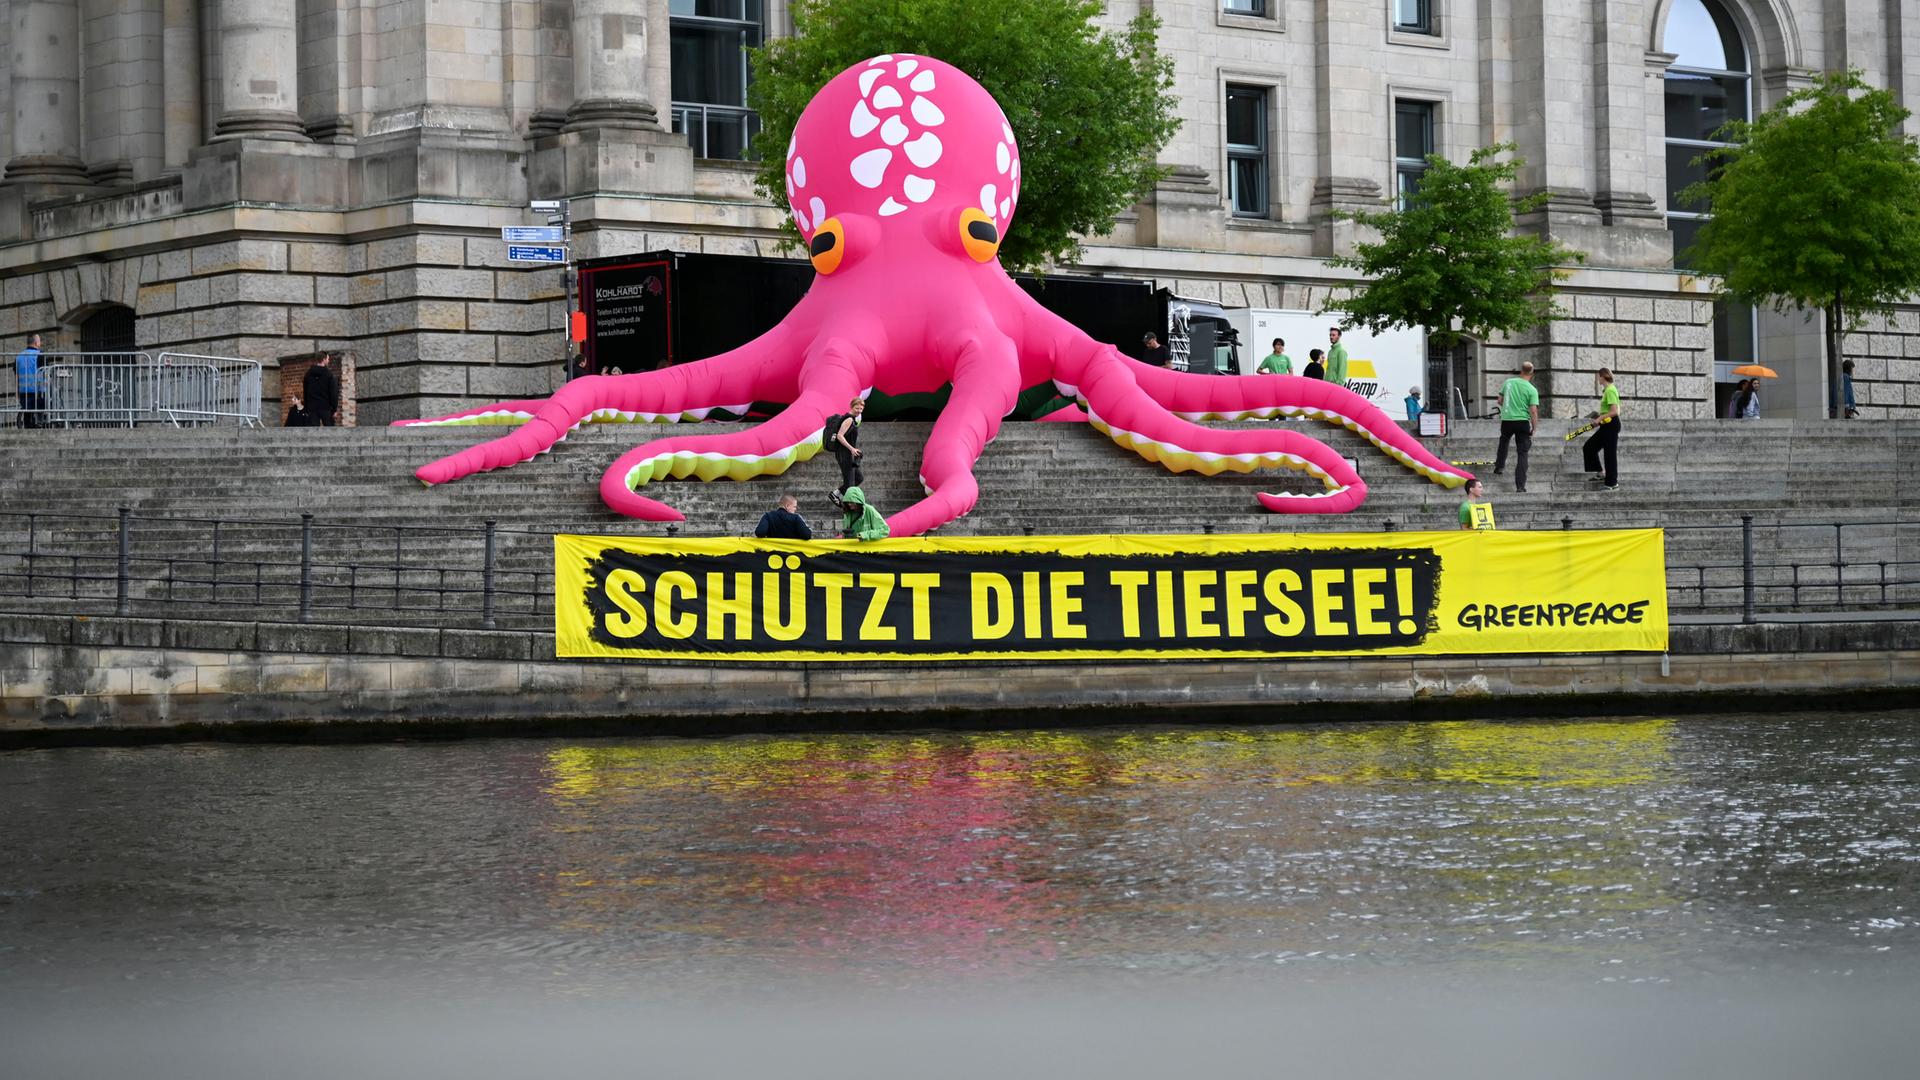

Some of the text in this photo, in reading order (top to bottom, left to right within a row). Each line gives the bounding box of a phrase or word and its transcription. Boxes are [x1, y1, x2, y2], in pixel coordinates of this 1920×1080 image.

[595, 287, 643, 298] KOHLHARDT
[597, 328, 635, 337] www.kohlhardt.de
[1344, 378, 1377, 399] kamp
[604, 554, 1419, 642] SCHÜTZT DIE TIEFSEE!
[1457, 600, 1650, 630] GREENPEACE
